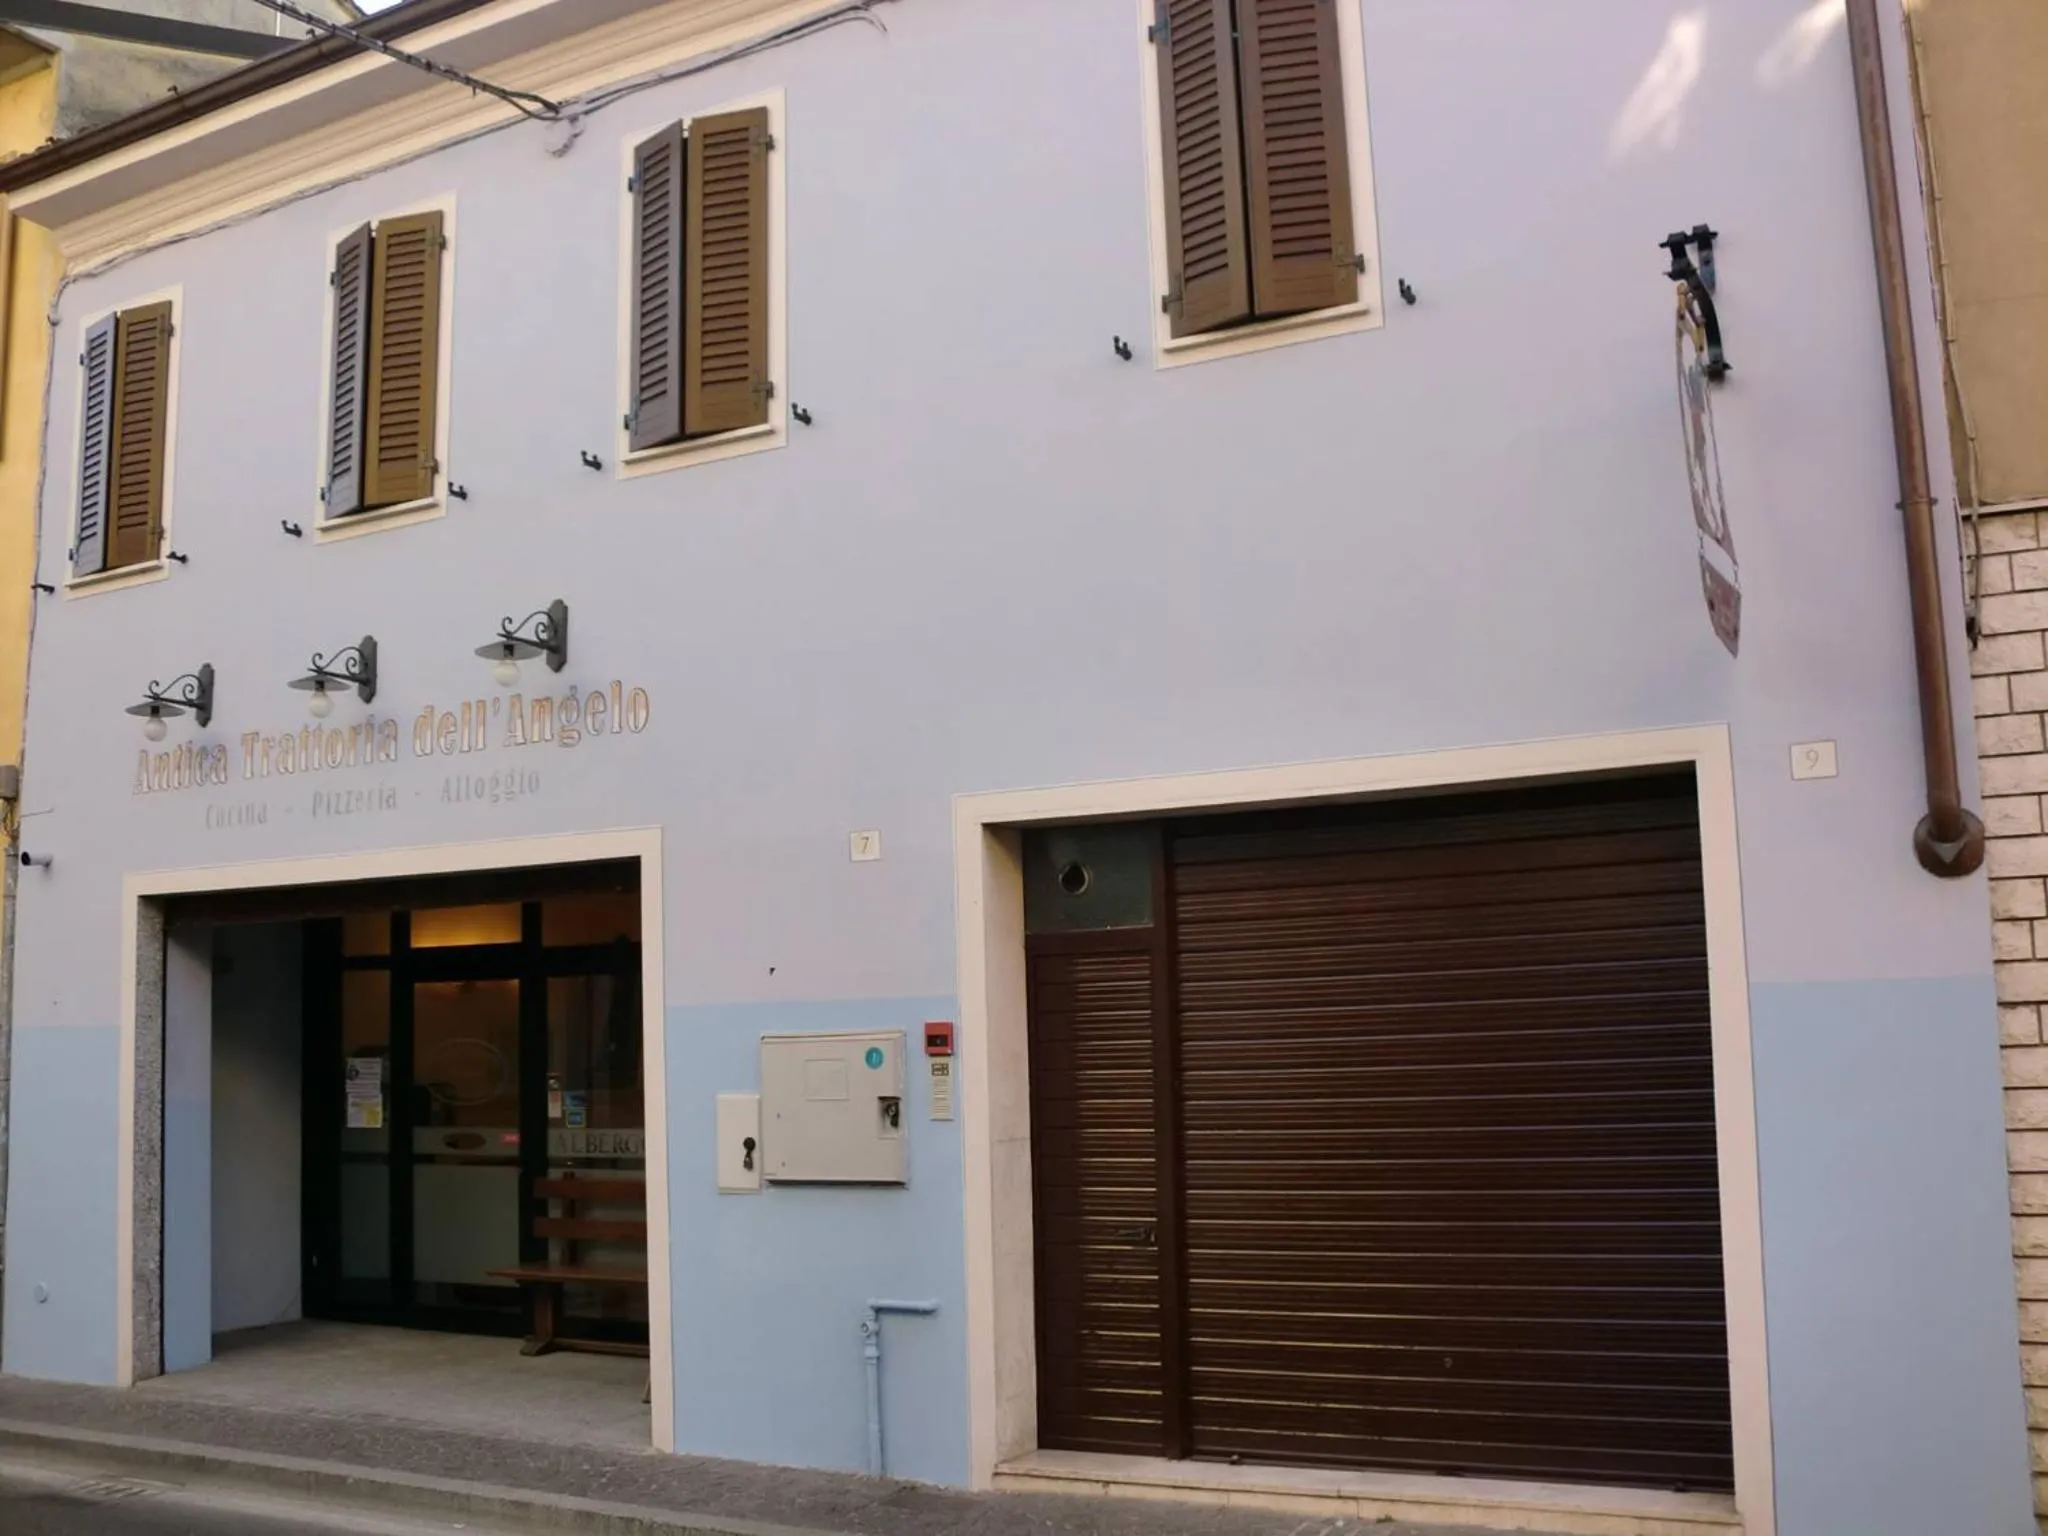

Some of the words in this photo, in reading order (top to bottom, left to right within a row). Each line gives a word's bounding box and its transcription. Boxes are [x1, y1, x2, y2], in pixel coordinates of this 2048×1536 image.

[132, 740, 229, 795] Antica
[241, 714, 399, 780] Trattoria
[413, 680, 650, 758] dell'Angelo
[1805, 749, 1819, 770] 9
[205, 801, 269, 830] Cucina
[311, 784, 398, 819] Pizzeria
[440, 767, 541, 804] Alloggio
[860, 836, 869, 854] 7
